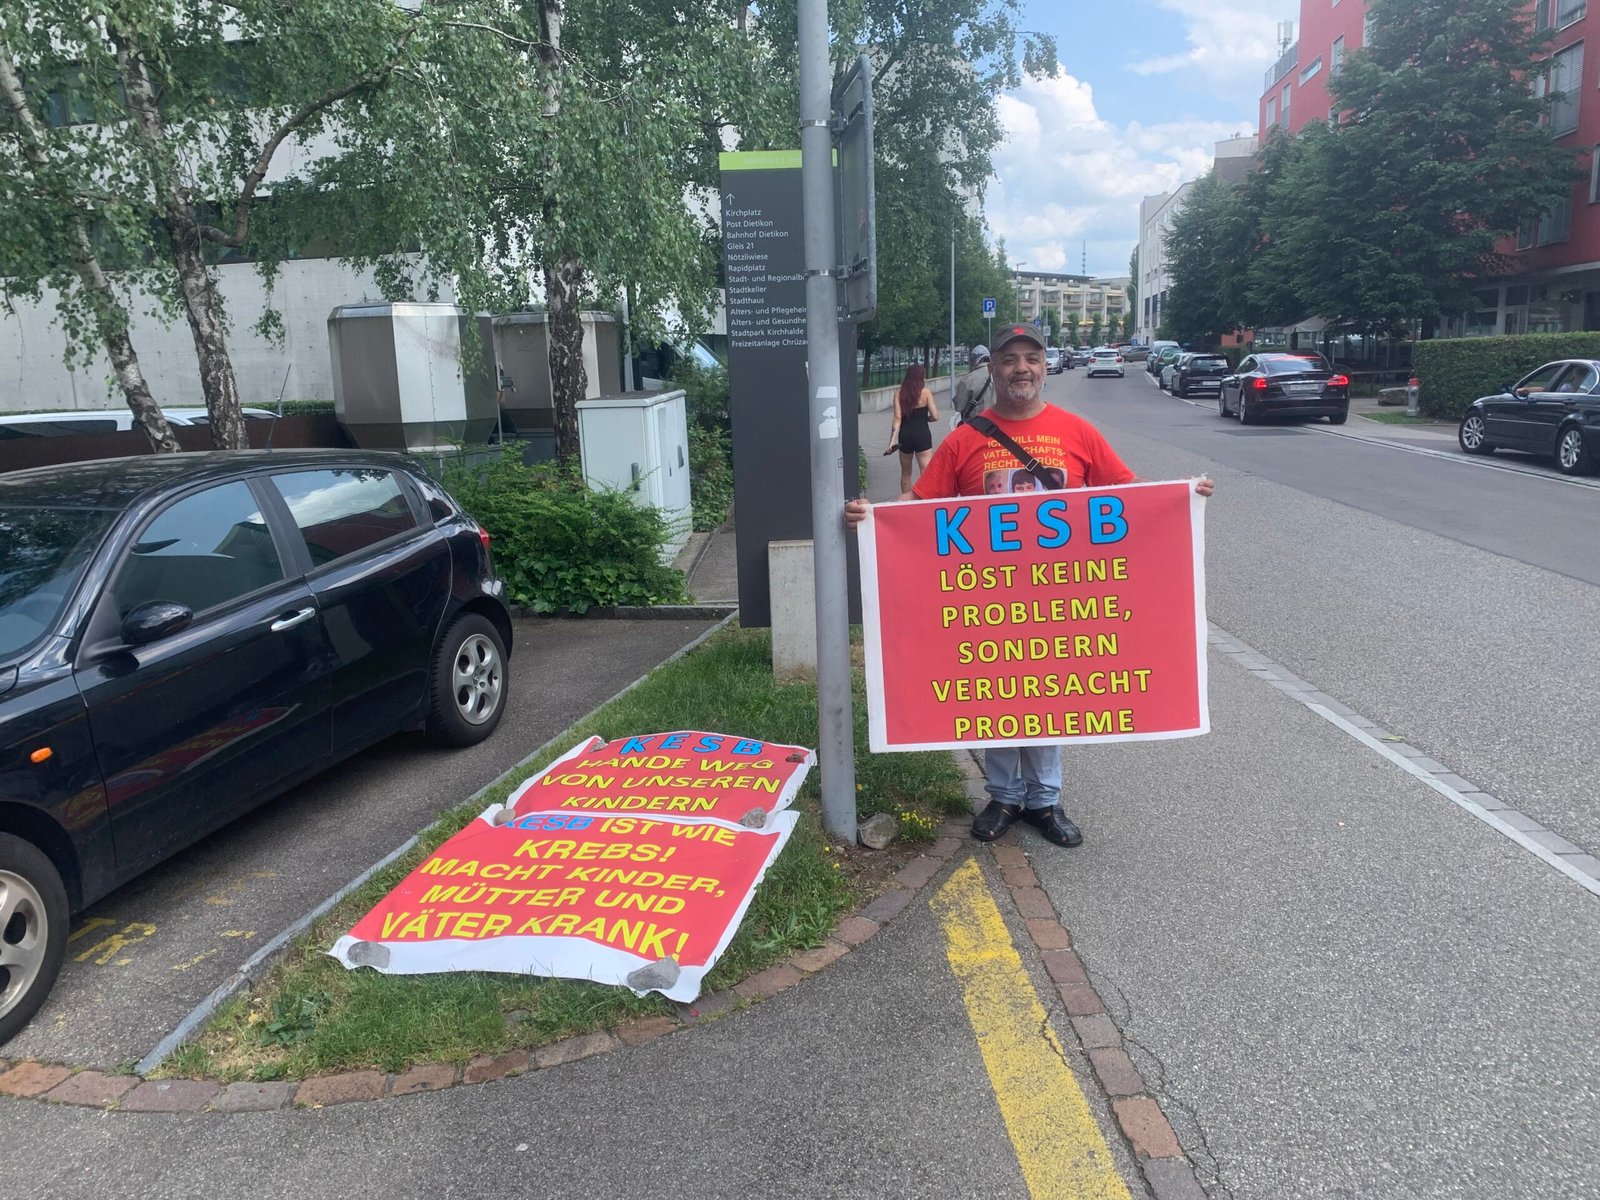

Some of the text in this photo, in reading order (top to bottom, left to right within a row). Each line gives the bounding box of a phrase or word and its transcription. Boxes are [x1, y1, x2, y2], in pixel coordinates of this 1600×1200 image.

[727, 231, 757, 239] Bahnhof
[727, 242, 744, 250] Gleis
[729, 264, 766, 272] Rapidplatz
[729, 275, 749, 283] Stadt-
[768, 273, 804, 281] Regionalb
[987, 301, 992, 311] P
[731, 318, 754, 326] Alters-
[772, 317, 806, 325] Gesundhe
[731, 329, 765, 337] Stadtpark
[732, 339, 780, 348] Freizeitanlage
[1037, 435, 1060, 444] MEIN
[984, 459, 1019, 470] RECHT
[934, 495, 1129, 556] KESB
[940, 557, 1128, 592] LÖST KEINE
[942, 595, 1133, 628] PROBLEME,
[958, 633, 1118, 664] SONDERN
[931, 669, 1152, 702] VERURSACHT
[955, 709, 1134, 740] PROBLEME
[619, 733, 764, 757] KESB
[576, 755, 774, 771] HÄNDE WEG
[541, 773, 782, 795] VON UNSEREN
[561, 795, 721, 812] KINDERN
[504, 815, 738, 847] ESB IST WIE
[513, 838, 677, 863] KREBS!
[420, 857, 726, 898] MACHT KINDER,
[420, 882, 685, 915] MÜTTER UND
[381, 909, 690, 961] VÄTER KRANK!
